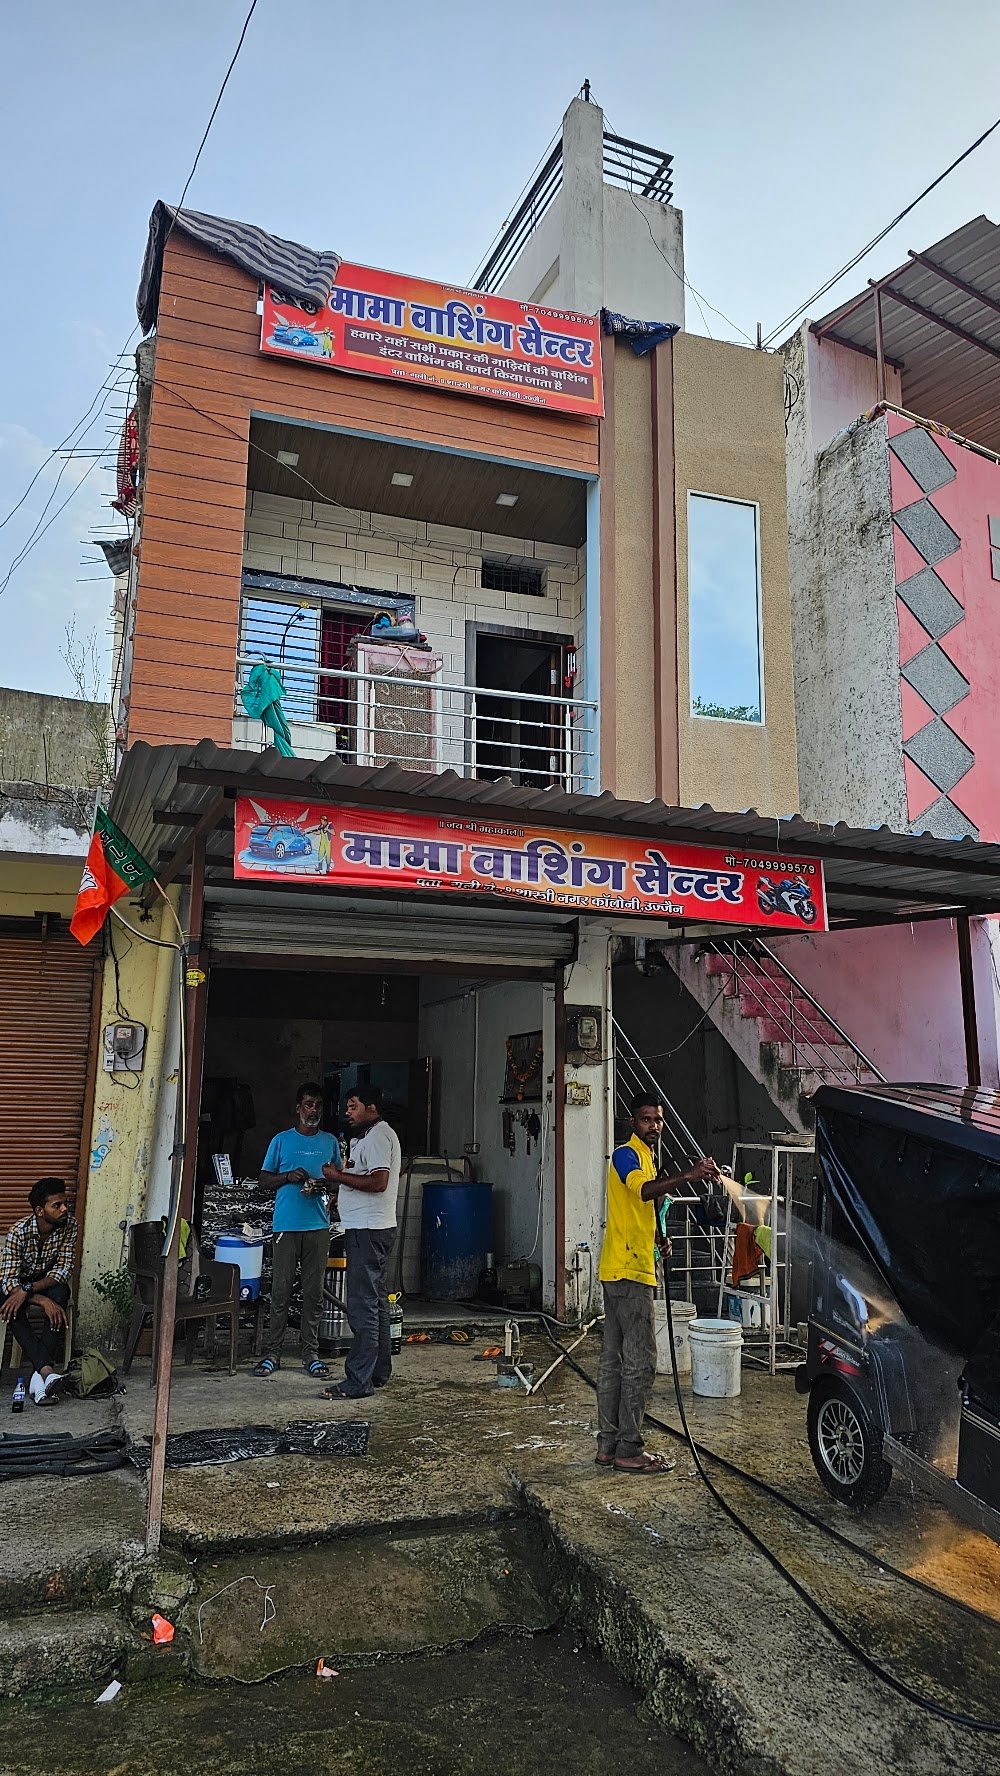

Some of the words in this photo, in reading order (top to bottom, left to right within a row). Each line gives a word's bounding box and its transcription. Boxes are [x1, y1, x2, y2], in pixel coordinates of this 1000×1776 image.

[328, 285, 406, 329] मामा
[409, 299, 516, 351] वाशिंग
[516, 314, 594, 368] सेन्टर
[350, 328, 383, 343] हमारे
[409, 341, 437, 354] सभी
[438, 347, 471, 361] प्रकार
[473, 353, 489, 365] की
[533, 365, 549, 377] की
[551, 370, 588, 385] वाशिंग
[378, 345, 403, 358] इंटर
[405, 352, 445, 367] वाशिंग
[447, 359, 463, 371] की
[465, 364, 492, 376] कार्य
[493, 367, 523, 383] किया
[525, 376, 552, 389] जाता
[554, 380, 563, 391] है
[445, 821, 463, 830] जय
[465, 823, 477, 832] श्री
[479, 825, 517, 836] महाकाल
[340, 829, 466, 875] मामा
[468, 837, 629, 893] वाशिंग
[631, 849, 744, 904] सेन्टर
[557, 893, 591, 905] नगर
